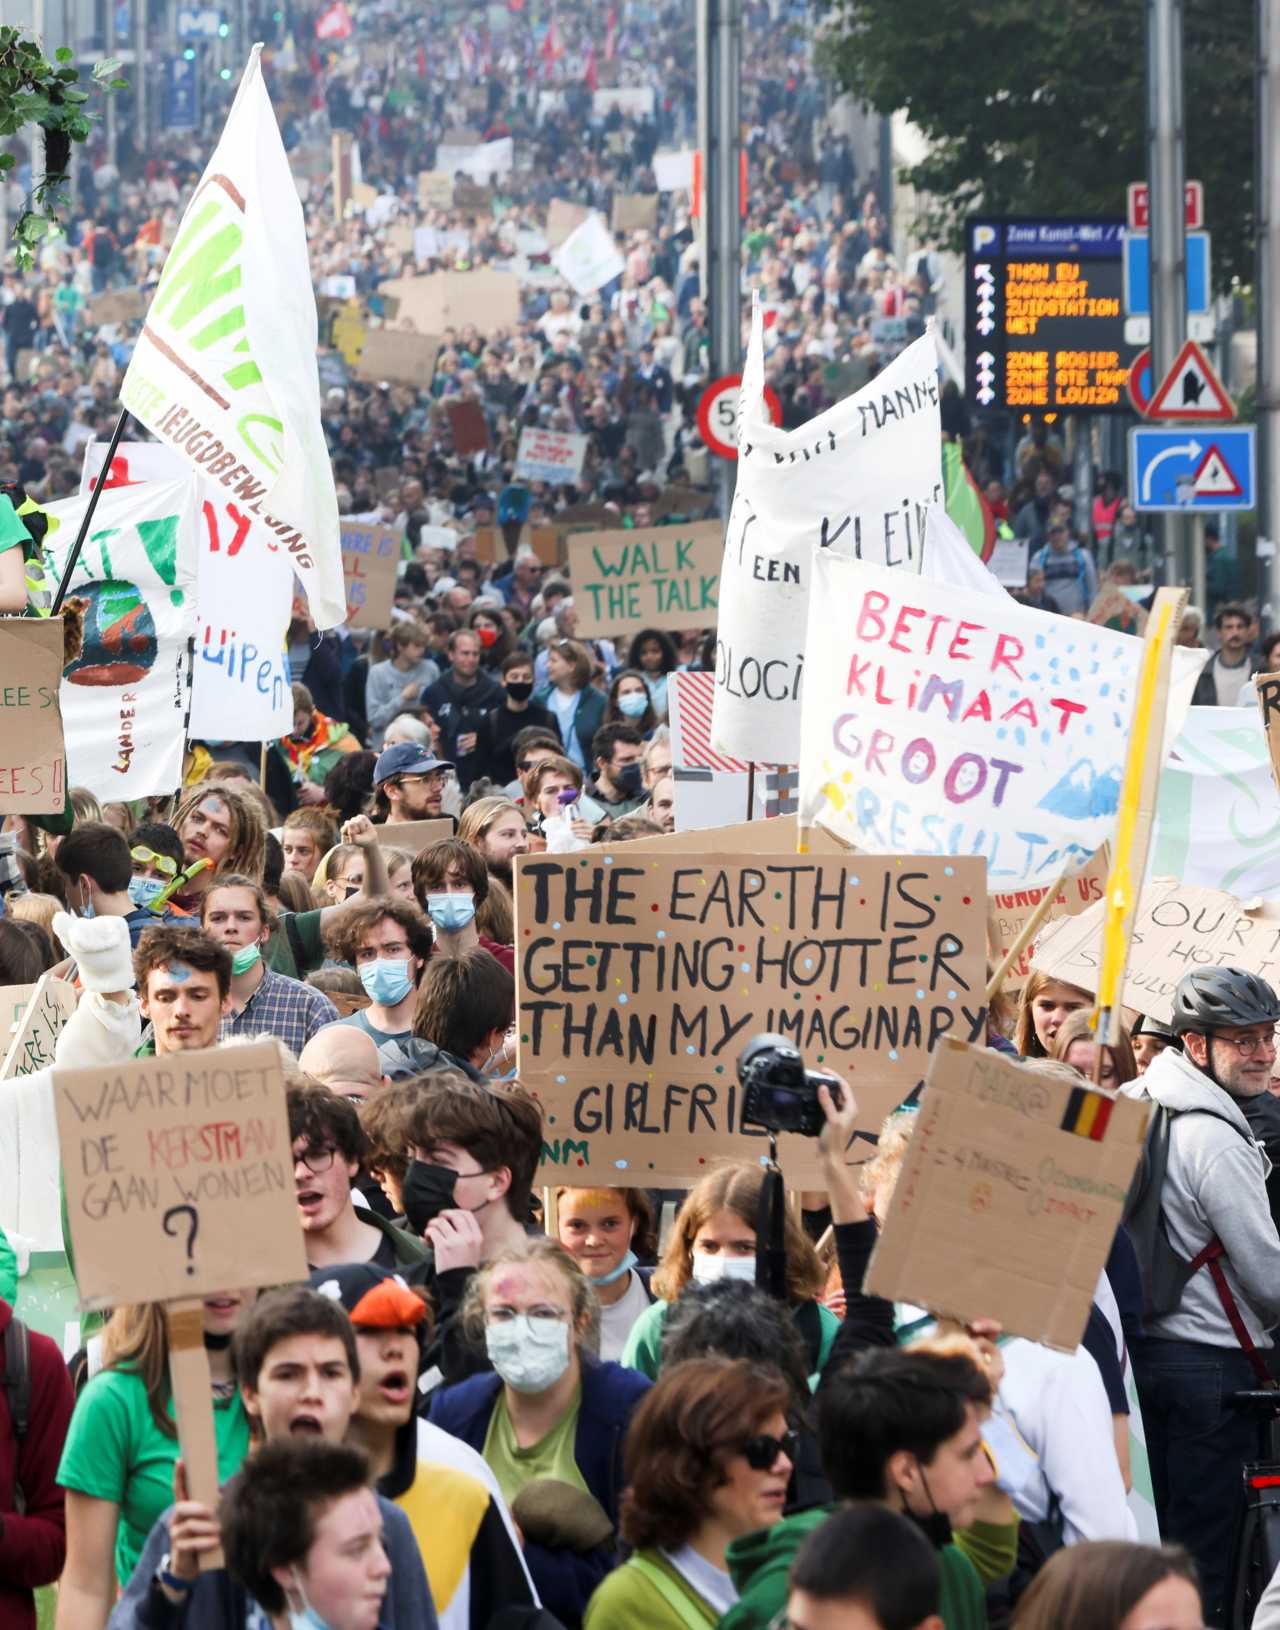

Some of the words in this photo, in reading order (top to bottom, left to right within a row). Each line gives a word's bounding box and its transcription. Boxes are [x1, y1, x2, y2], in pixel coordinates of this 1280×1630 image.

[718, 400, 736, 427] 5
[592, 538, 696, 577] WALK
[583, 582, 641, 621] THE
[651, 575, 718, 613] TALK
[856, 590, 1025, 681] BETER
[832, 712, 1024, 808] GROOT
[522, 863, 646, 925] THE
[669, 865, 847, 930] EARTH
[880, 871, 936, 931] IS
[1076, 877, 1104, 902] US
[1151, 900, 1254, 946] OUR
[523, 936, 735, 995] GETTING
[756, 932, 970, 992] HOTTER
[1167, 939, 1236, 966] HOT
[521, 1001, 658, 1065] THAN
[670, 1003, 754, 1057] MY
[766, 1003, 988, 1053] IMAGINARY
[63, 1072, 177, 1123] WAAR
[183, 1066, 279, 1108] MOET
[81, 1134, 124, 1177] DE
[146, 1119, 278, 1169] KERSTMAN
[81, 1176, 160, 1222] GAAN
[173, 1162, 287, 1204] WONEN
[162, 1203, 199, 1277] ?
